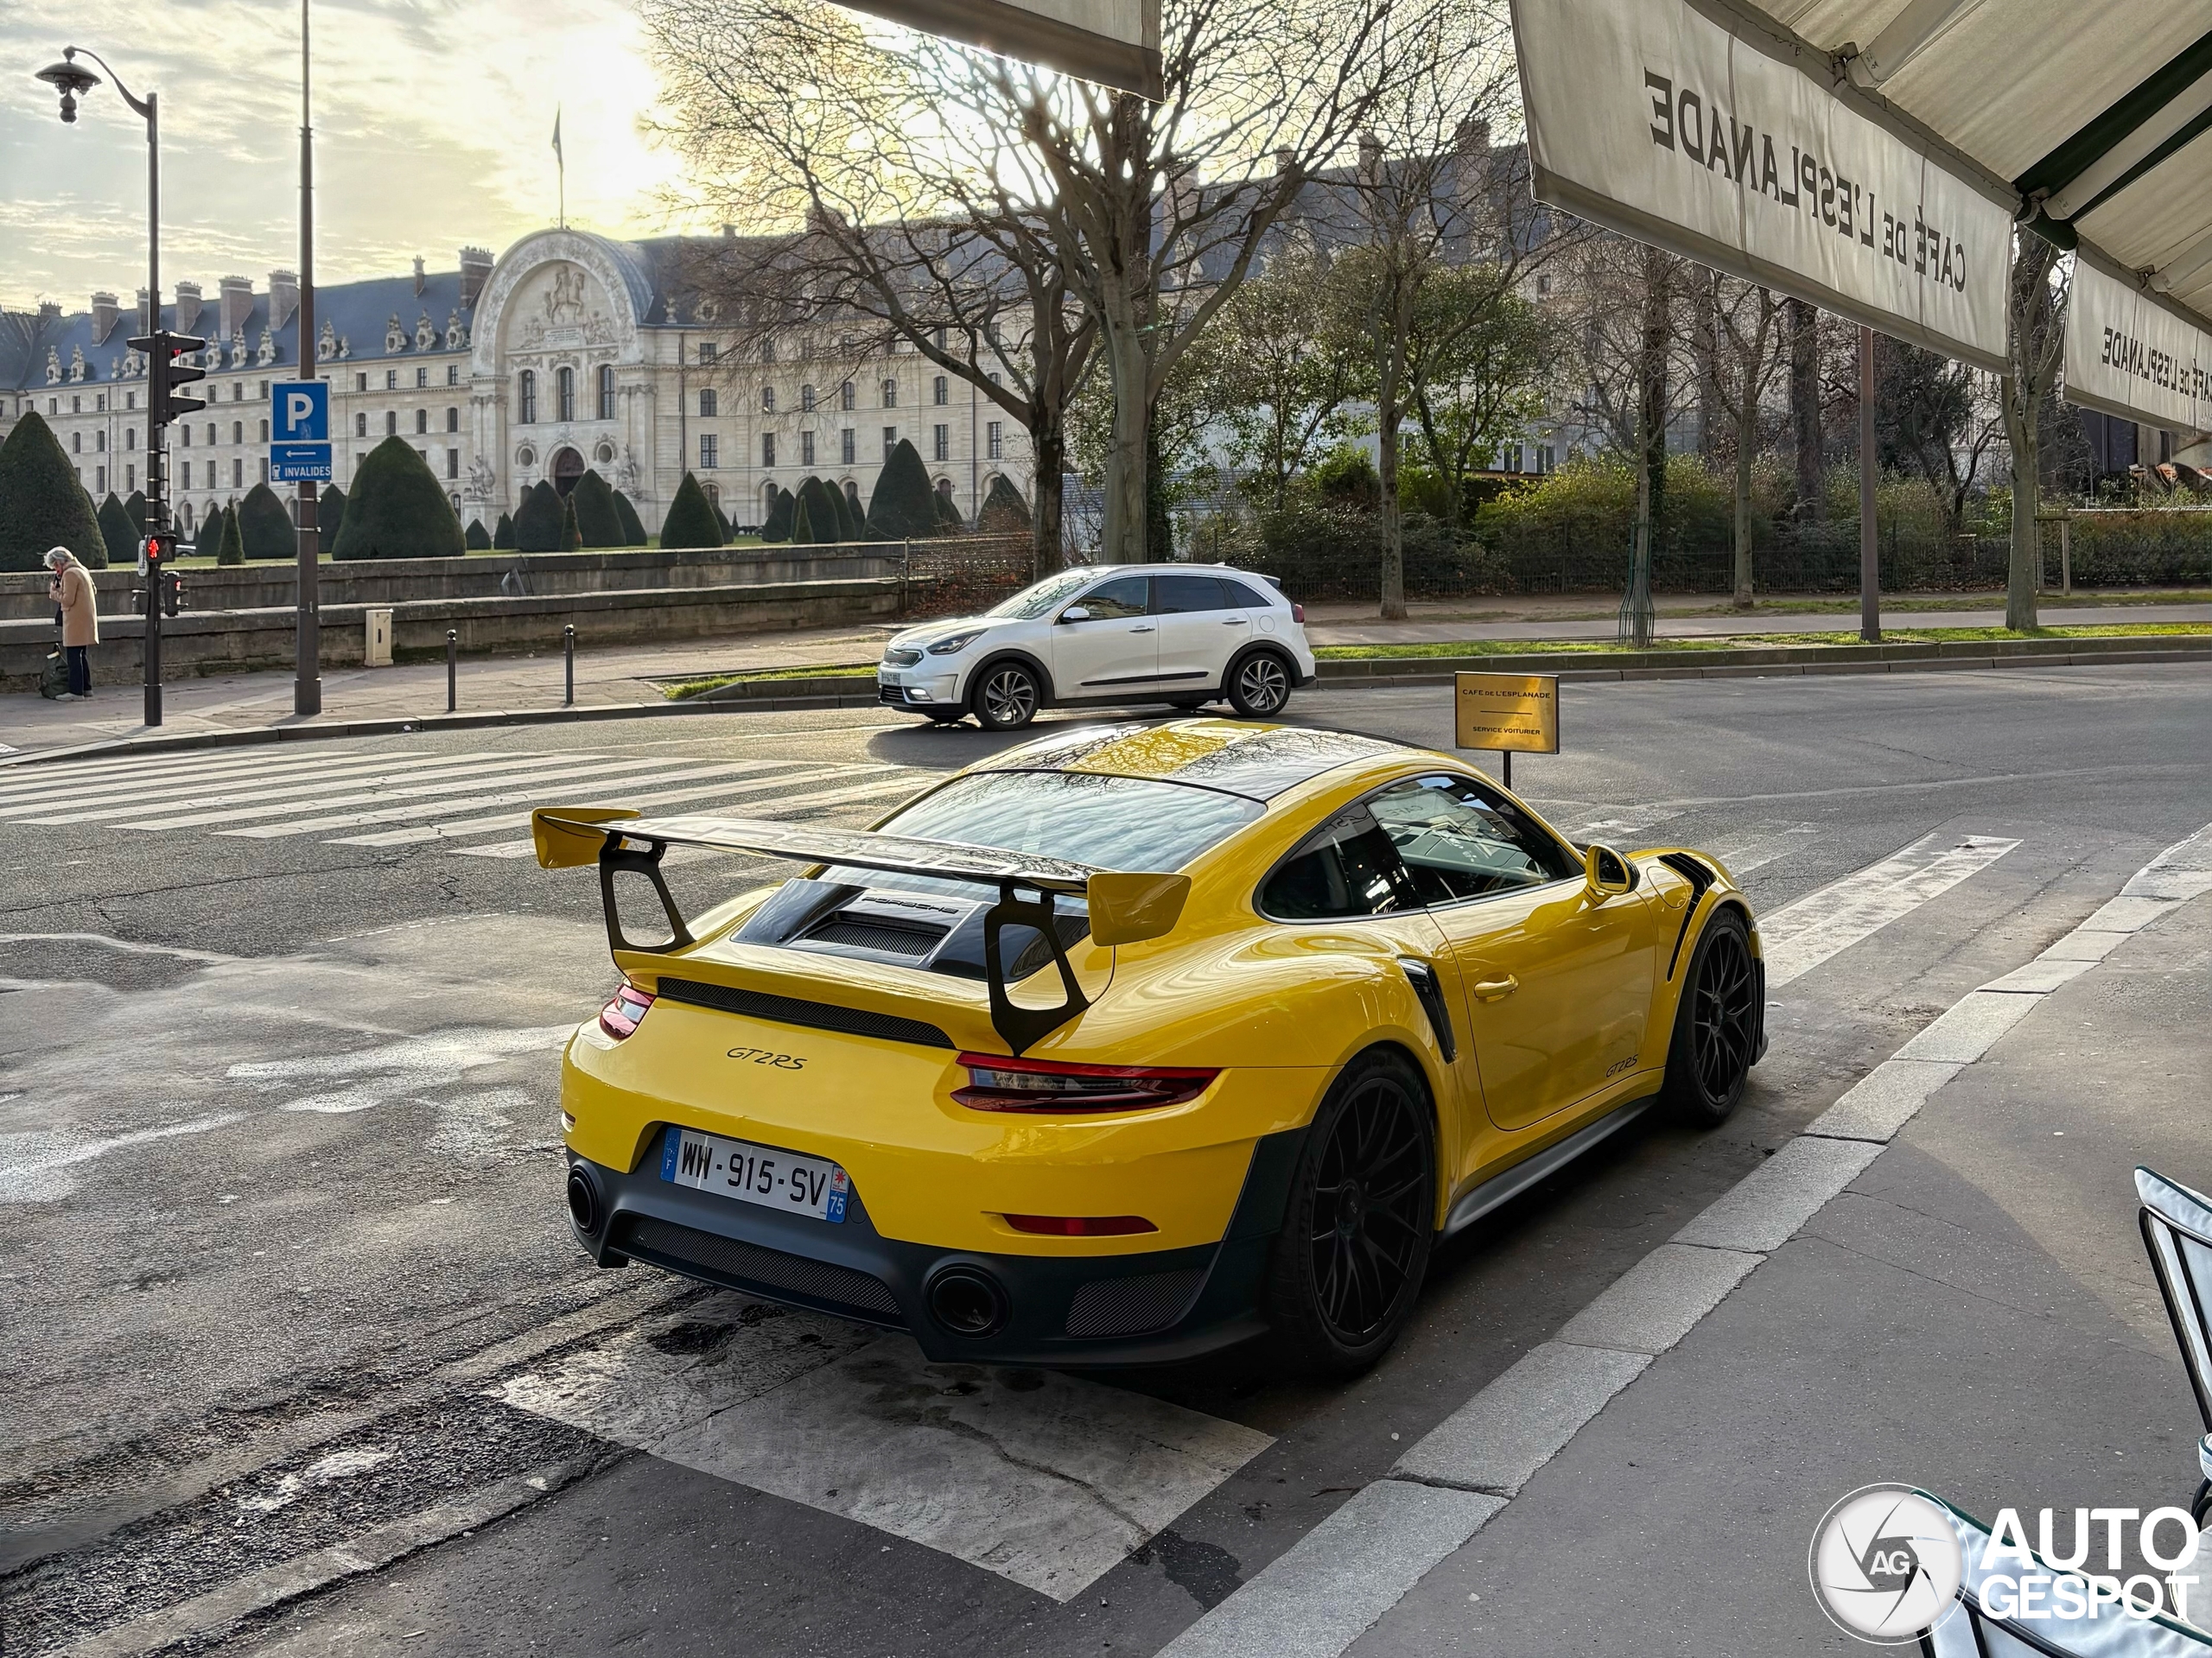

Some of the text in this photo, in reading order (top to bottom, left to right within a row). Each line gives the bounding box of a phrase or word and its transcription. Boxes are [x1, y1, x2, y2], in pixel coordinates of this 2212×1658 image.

[288, 392, 314, 431] P
[284, 466, 331, 477] INVALIDES
[1496, 690, 1551, 699] L'ESPLANADE
[861, 896, 959, 915] PORSCHE
[665, 1159, 672, 1170] F
[830, 1195, 844, 1215] 75
